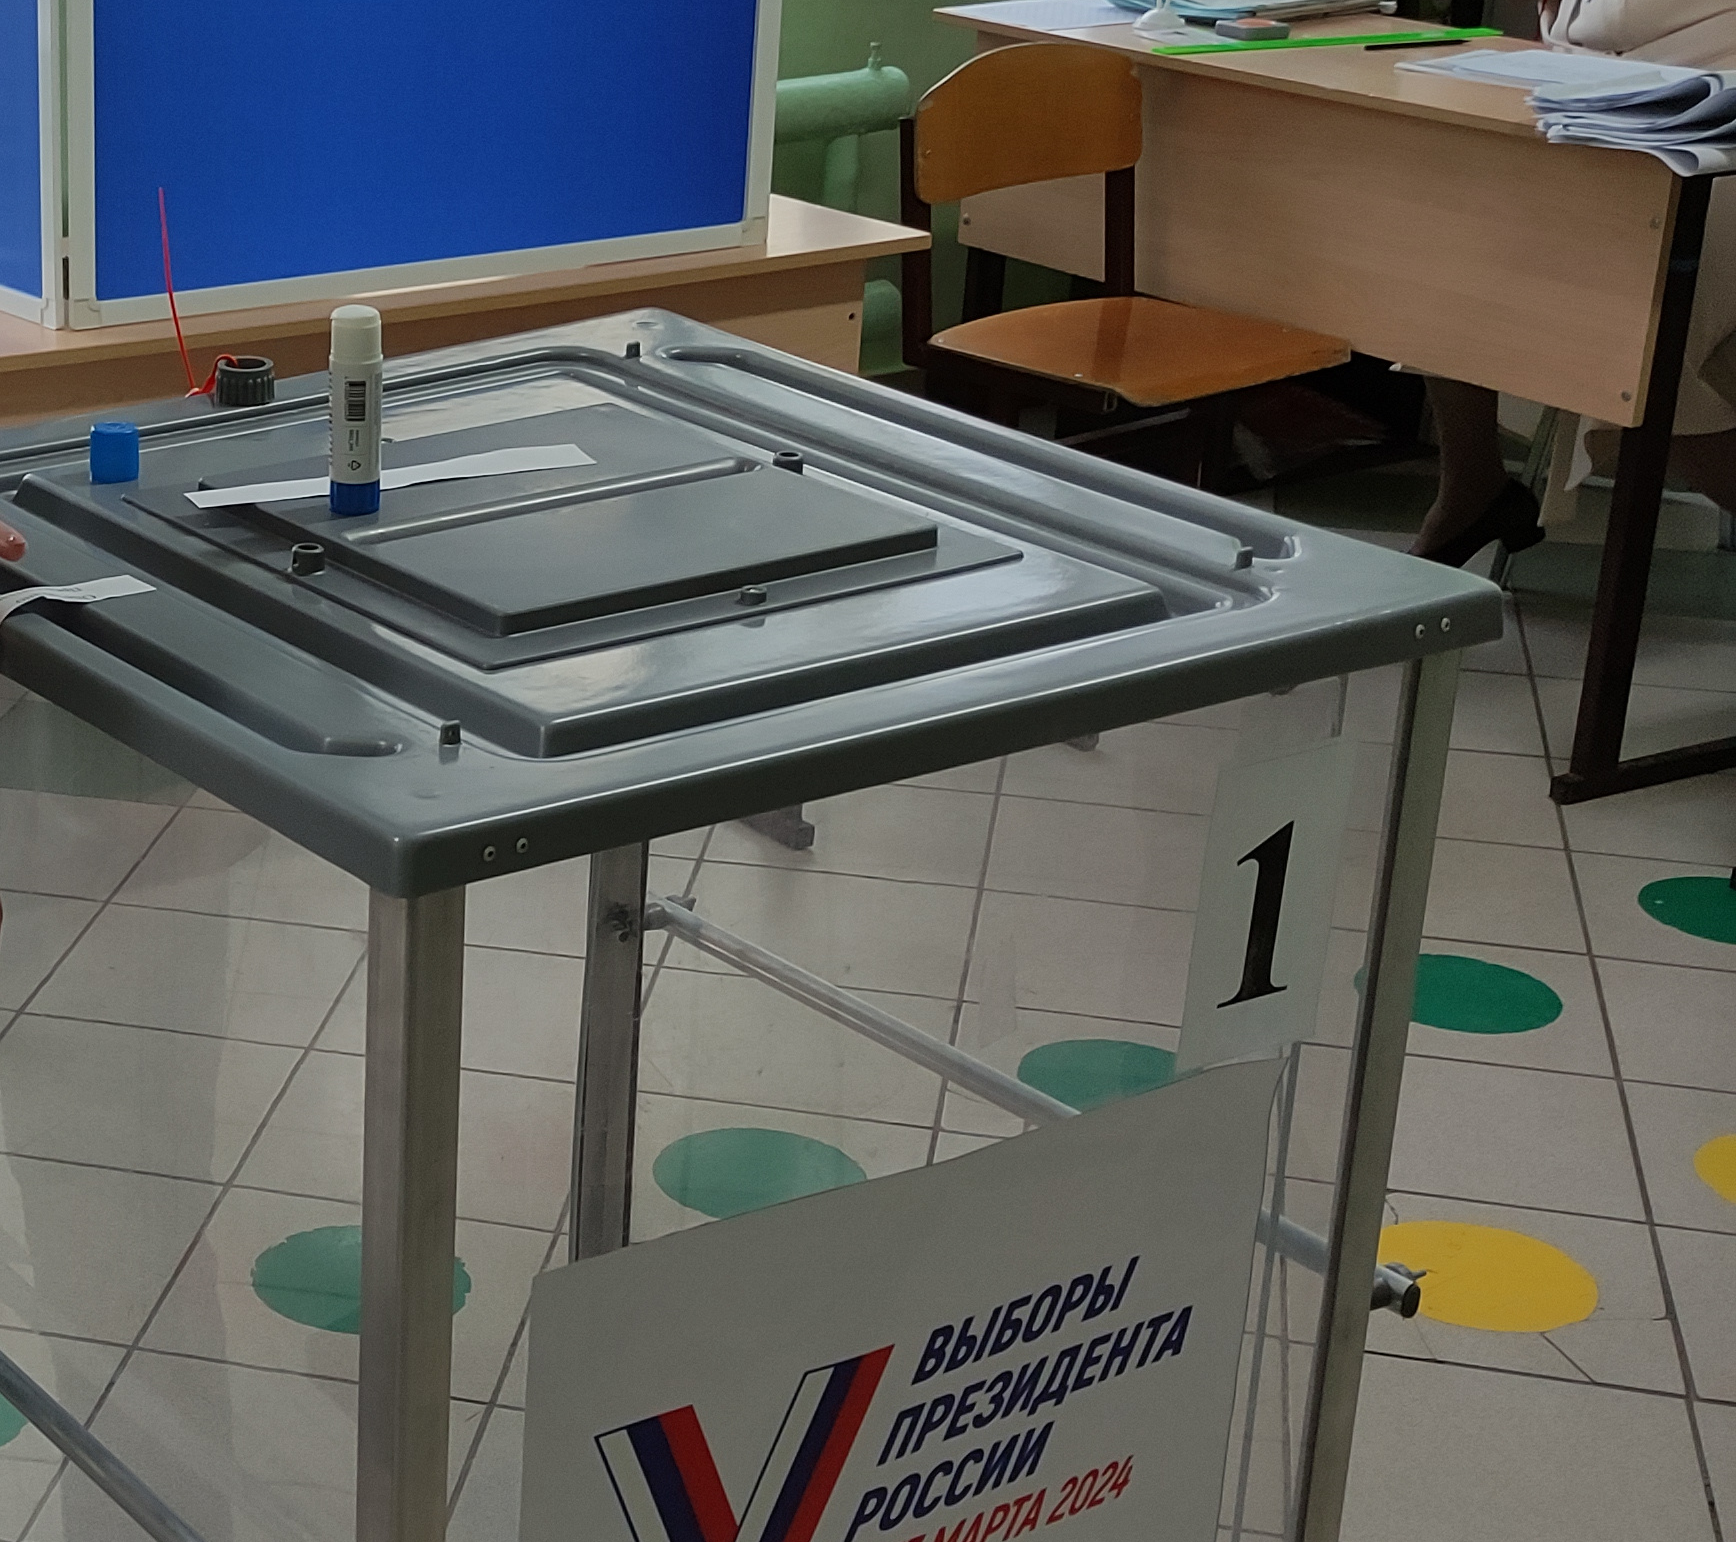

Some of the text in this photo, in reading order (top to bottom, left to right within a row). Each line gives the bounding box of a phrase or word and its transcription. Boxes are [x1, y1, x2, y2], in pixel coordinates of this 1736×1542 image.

[1216, 820, 1295, 1009] 1
[876, 1305, 1193, 1467] ПРЕЗИДЕНТА
[912, 1255, 1140, 1386] ВЫБОРЫ
[1046, 1455, 1134, 1526] 2024
